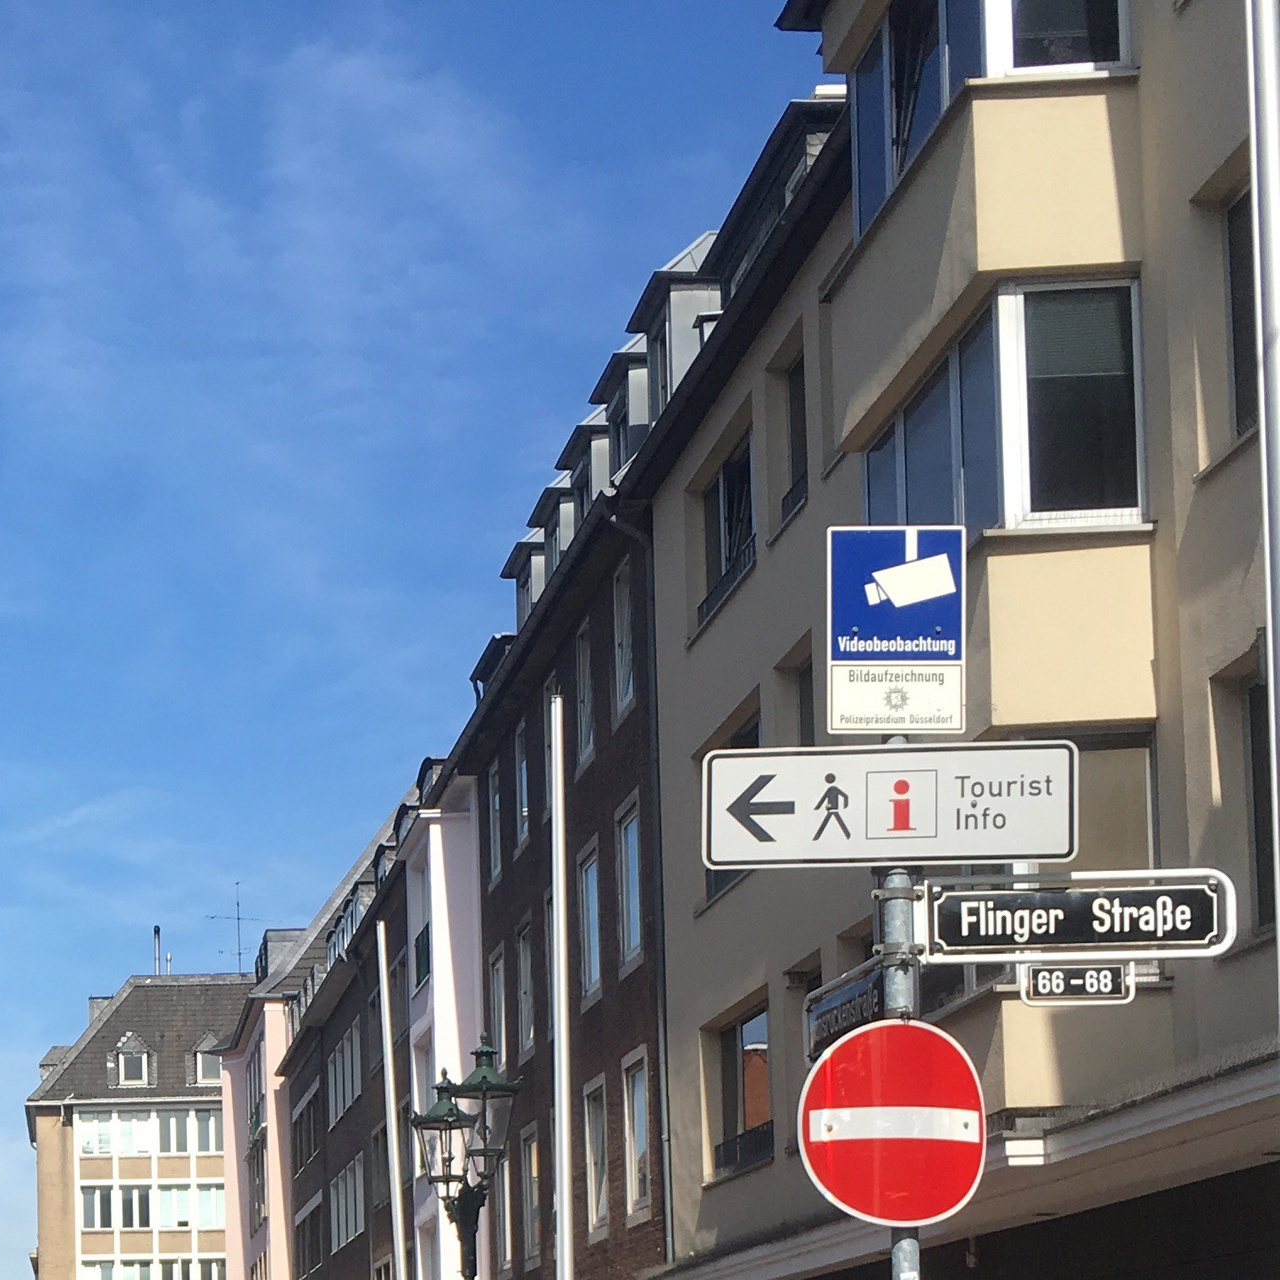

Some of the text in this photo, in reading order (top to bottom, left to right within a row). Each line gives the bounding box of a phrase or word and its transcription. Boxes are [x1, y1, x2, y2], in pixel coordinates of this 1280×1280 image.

[837, 636, 956, 656] Videobeobachtung
[848, 669, 945, 686] Bildaufzeichnung
[839, 714, 953, 726] Polizeipräsidium Düsseldorf
[955, 774, 1053, 799] Tourist
[956, 807, 1007, 831] Info
[960, 895, 1192, 943] Flinger Straße
